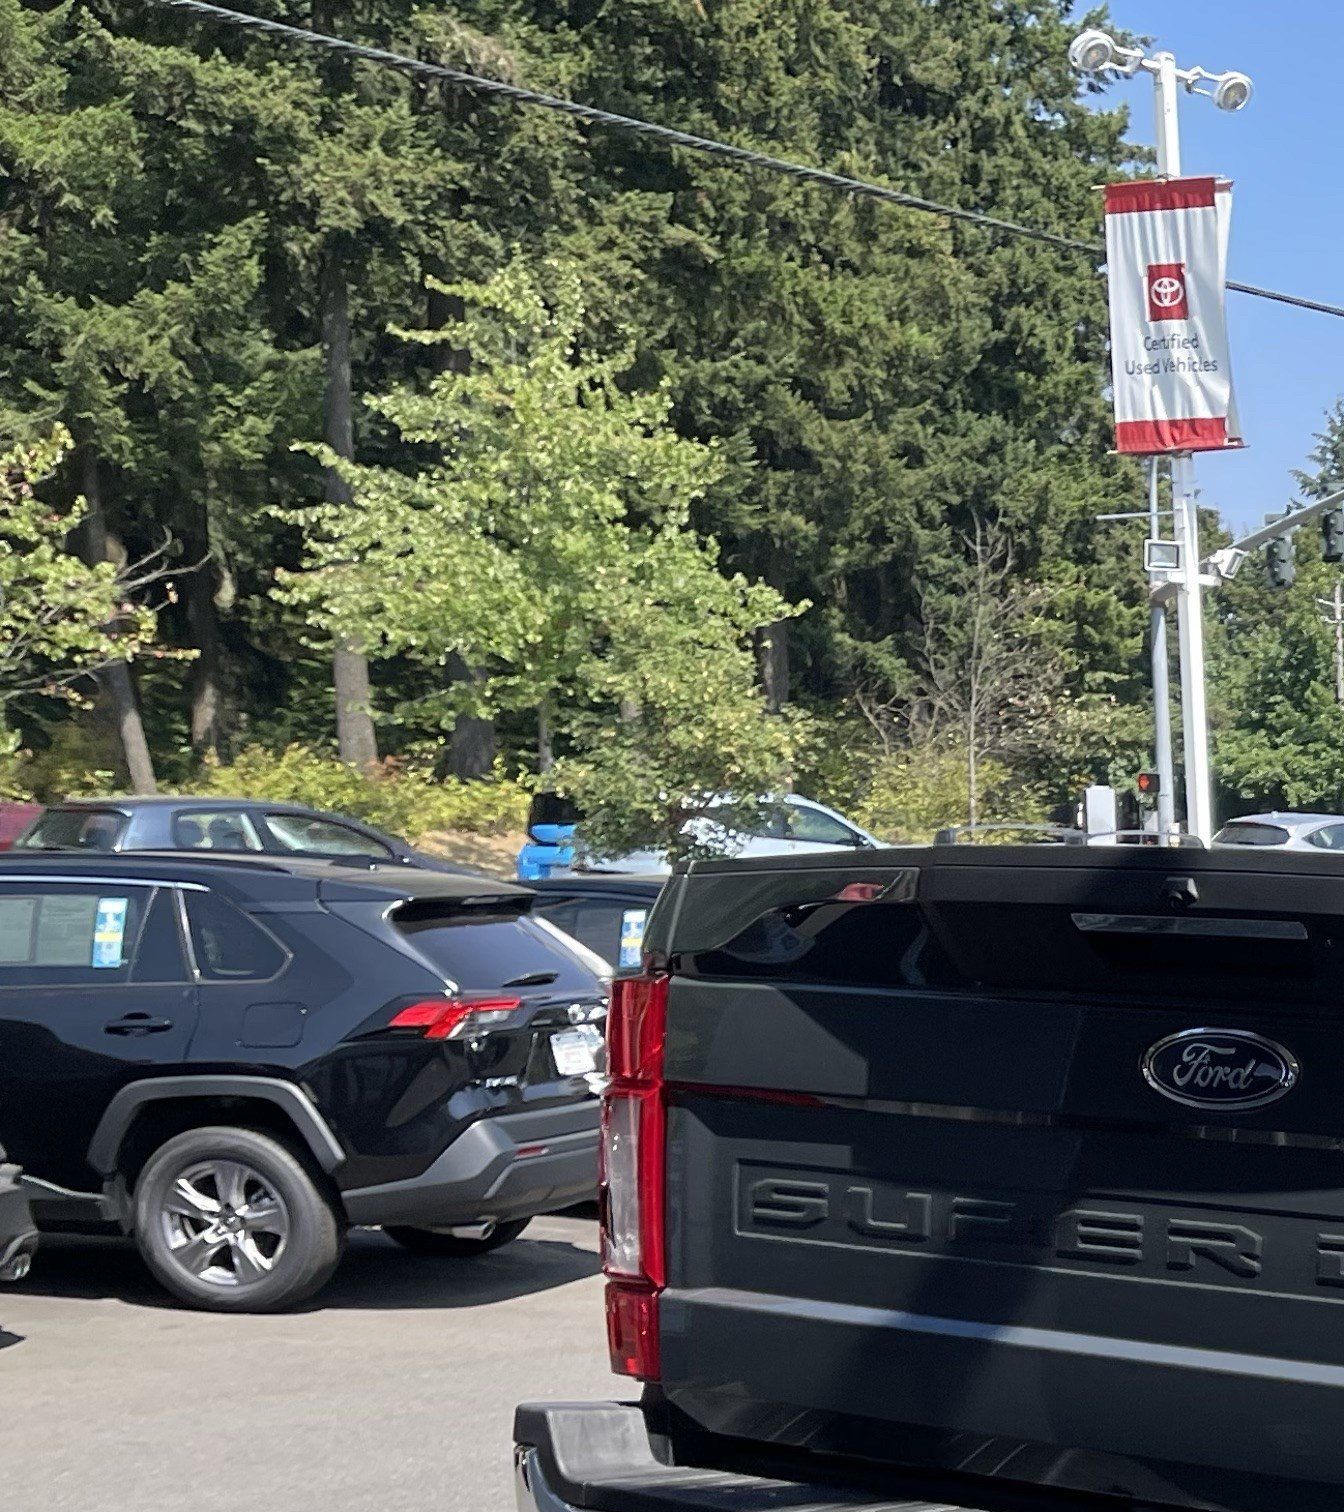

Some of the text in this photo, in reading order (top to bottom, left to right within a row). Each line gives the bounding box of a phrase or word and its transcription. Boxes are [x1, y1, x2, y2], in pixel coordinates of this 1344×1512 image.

[1144, 333, 1199, 351] Certified
[1125, 356, 1218, 375] Used Vehicles
[1172, 1043, 1256, 1090] Ford
[750, 1177, 1264, 1280] SUPER
